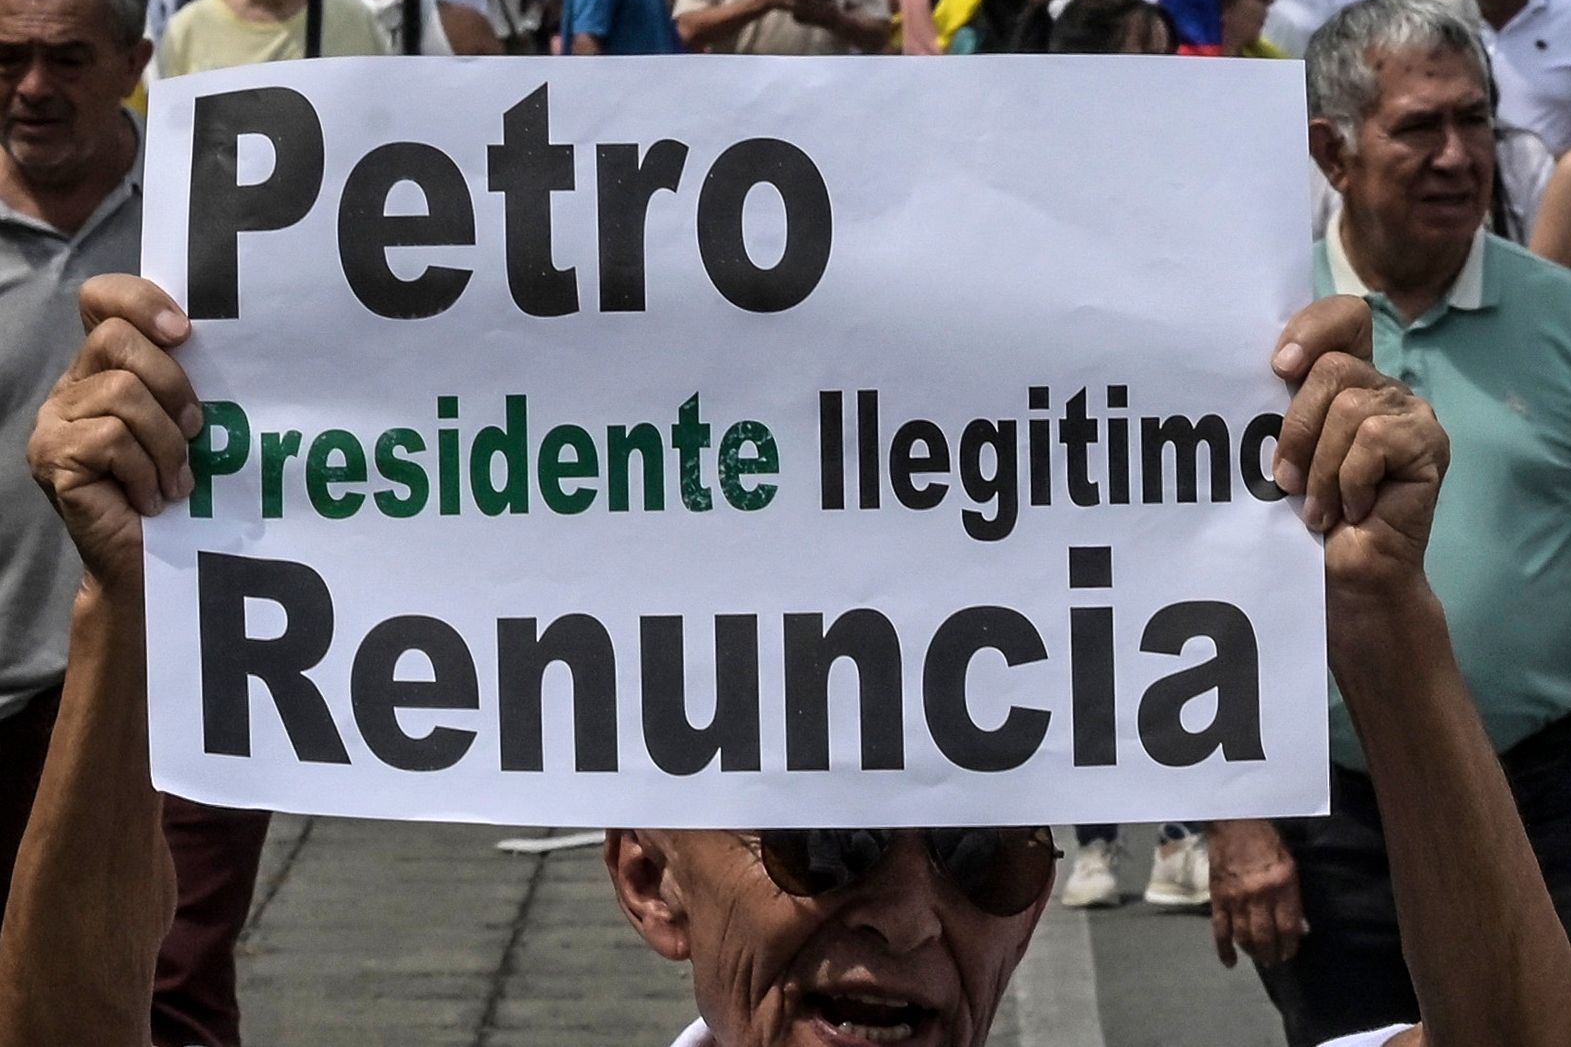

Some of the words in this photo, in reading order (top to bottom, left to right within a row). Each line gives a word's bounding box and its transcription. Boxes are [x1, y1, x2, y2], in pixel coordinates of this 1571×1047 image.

[187, 82, 833, 320] Petro
[188, 391, 780, 520] Presidente
[197, 546, 1266, 776] Renuncia
